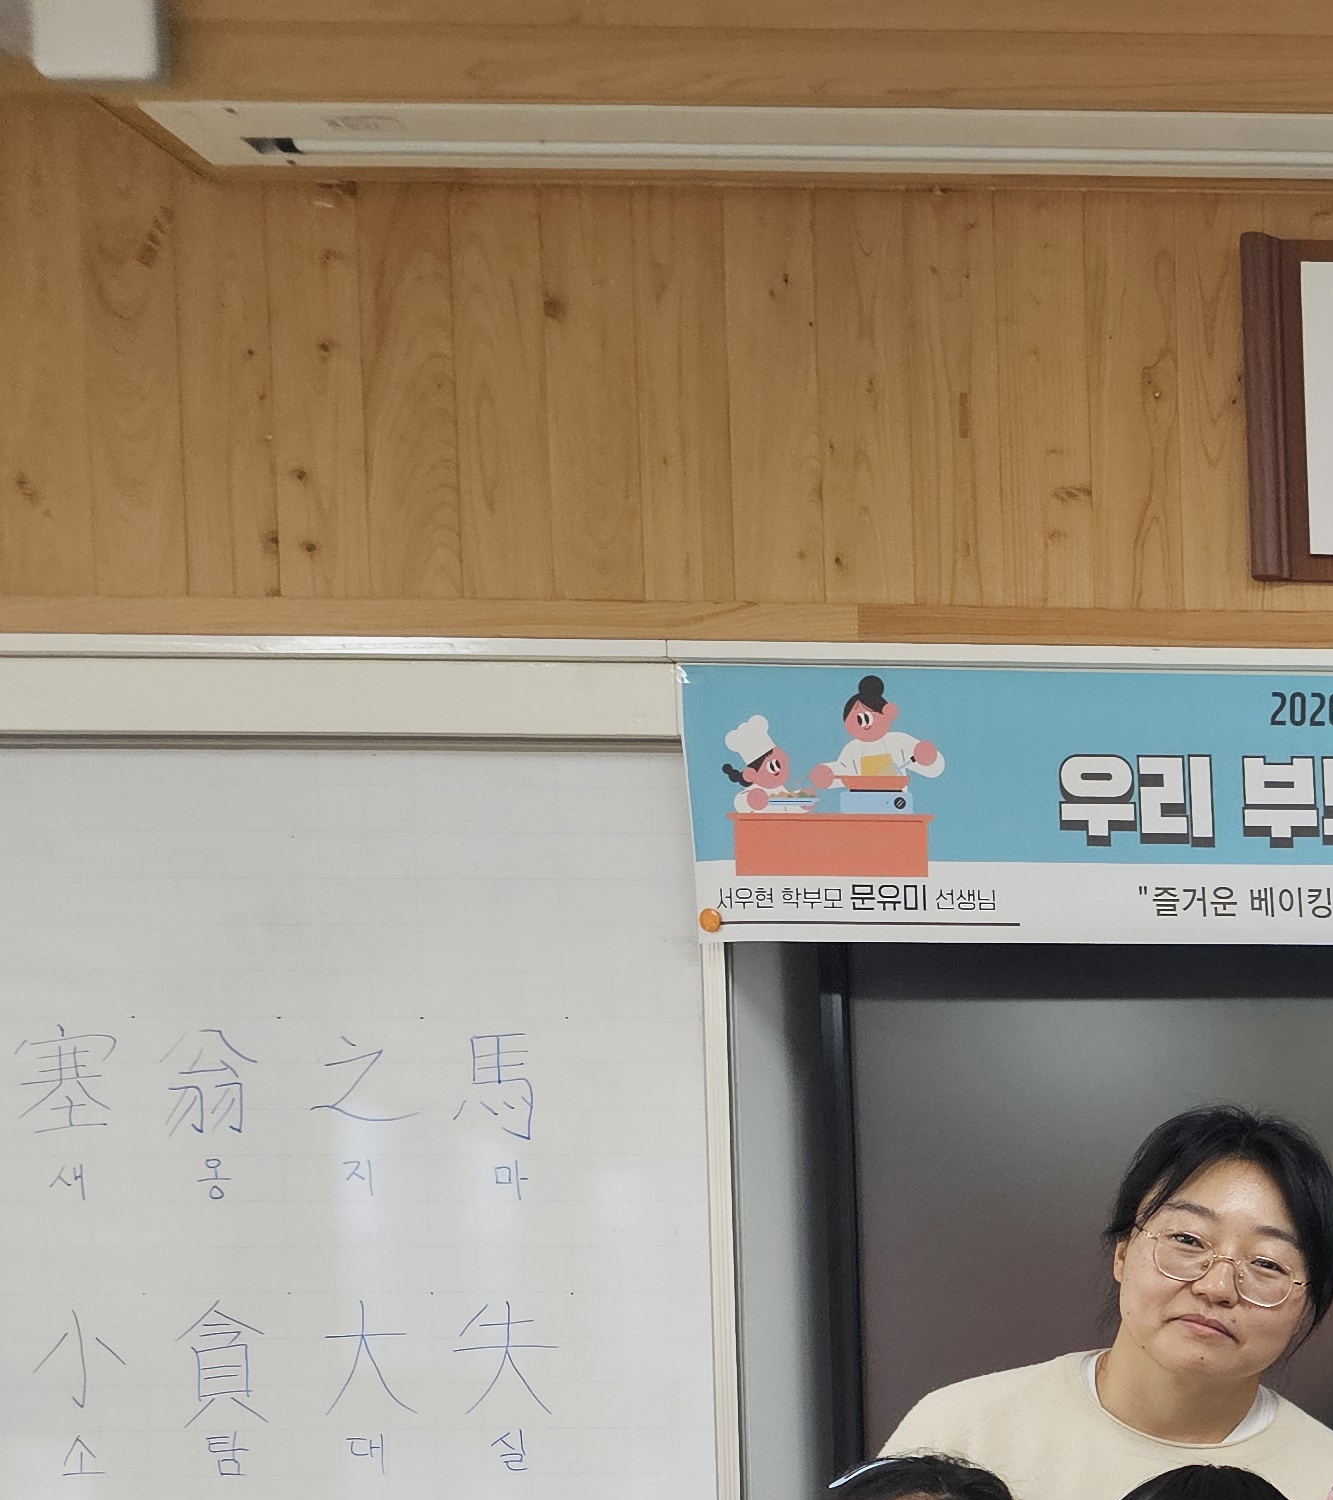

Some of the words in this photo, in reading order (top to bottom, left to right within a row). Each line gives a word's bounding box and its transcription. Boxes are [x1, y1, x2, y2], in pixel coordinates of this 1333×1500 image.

[1058, 753, 1215, 848] 우리
[717, 887, 774, 909] 서우현
[781, 887, 844, 910] 학부모
[850, 883, 928, 911] 문유미
[935, 888, 996, 911] 선생님
[1138, 885, 1238, 918] "즐거운
[1250, 886, 1332, 919] 베이킹
